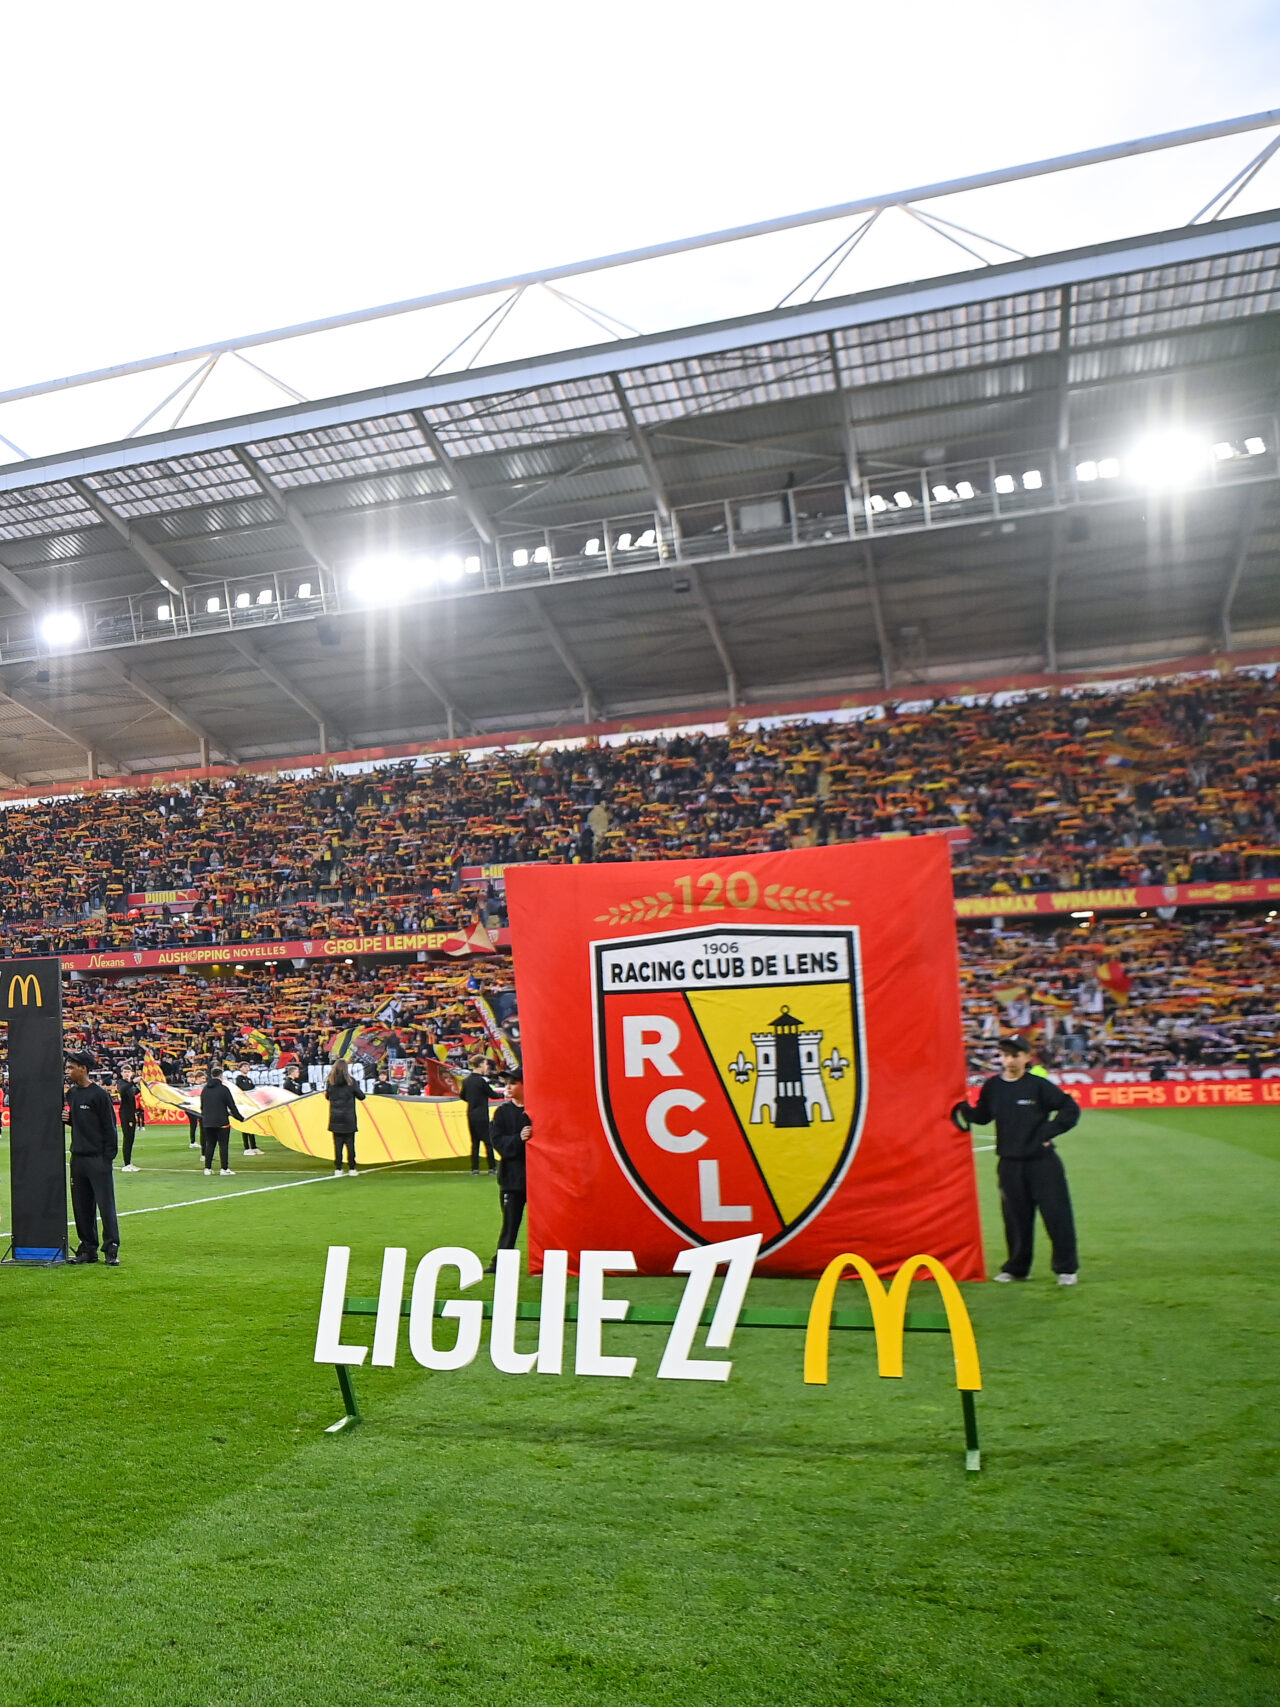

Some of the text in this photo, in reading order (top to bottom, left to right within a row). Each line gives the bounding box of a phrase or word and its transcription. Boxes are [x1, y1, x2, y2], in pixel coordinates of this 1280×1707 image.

[145, 891, 177, 905] PUMA
[673, 871, 759, 914] 120
[1051, 888, 1137, 910] WINAMAX
[233, 945, 286, 958] NOYELLES
[324, 938, 382, 954] GROUPE
[702, 942, 739, 955] 1906
[88, 954, 125, 968] Nexans
[611, 951, 839, 984] RACING CLUB DE LENS
[1090, 1086, 1167, 1105] FIERS
[1174, 1082, 1254, 1104] D'ÊTRE
[313, 1246, 638, 1379] LIGUE
